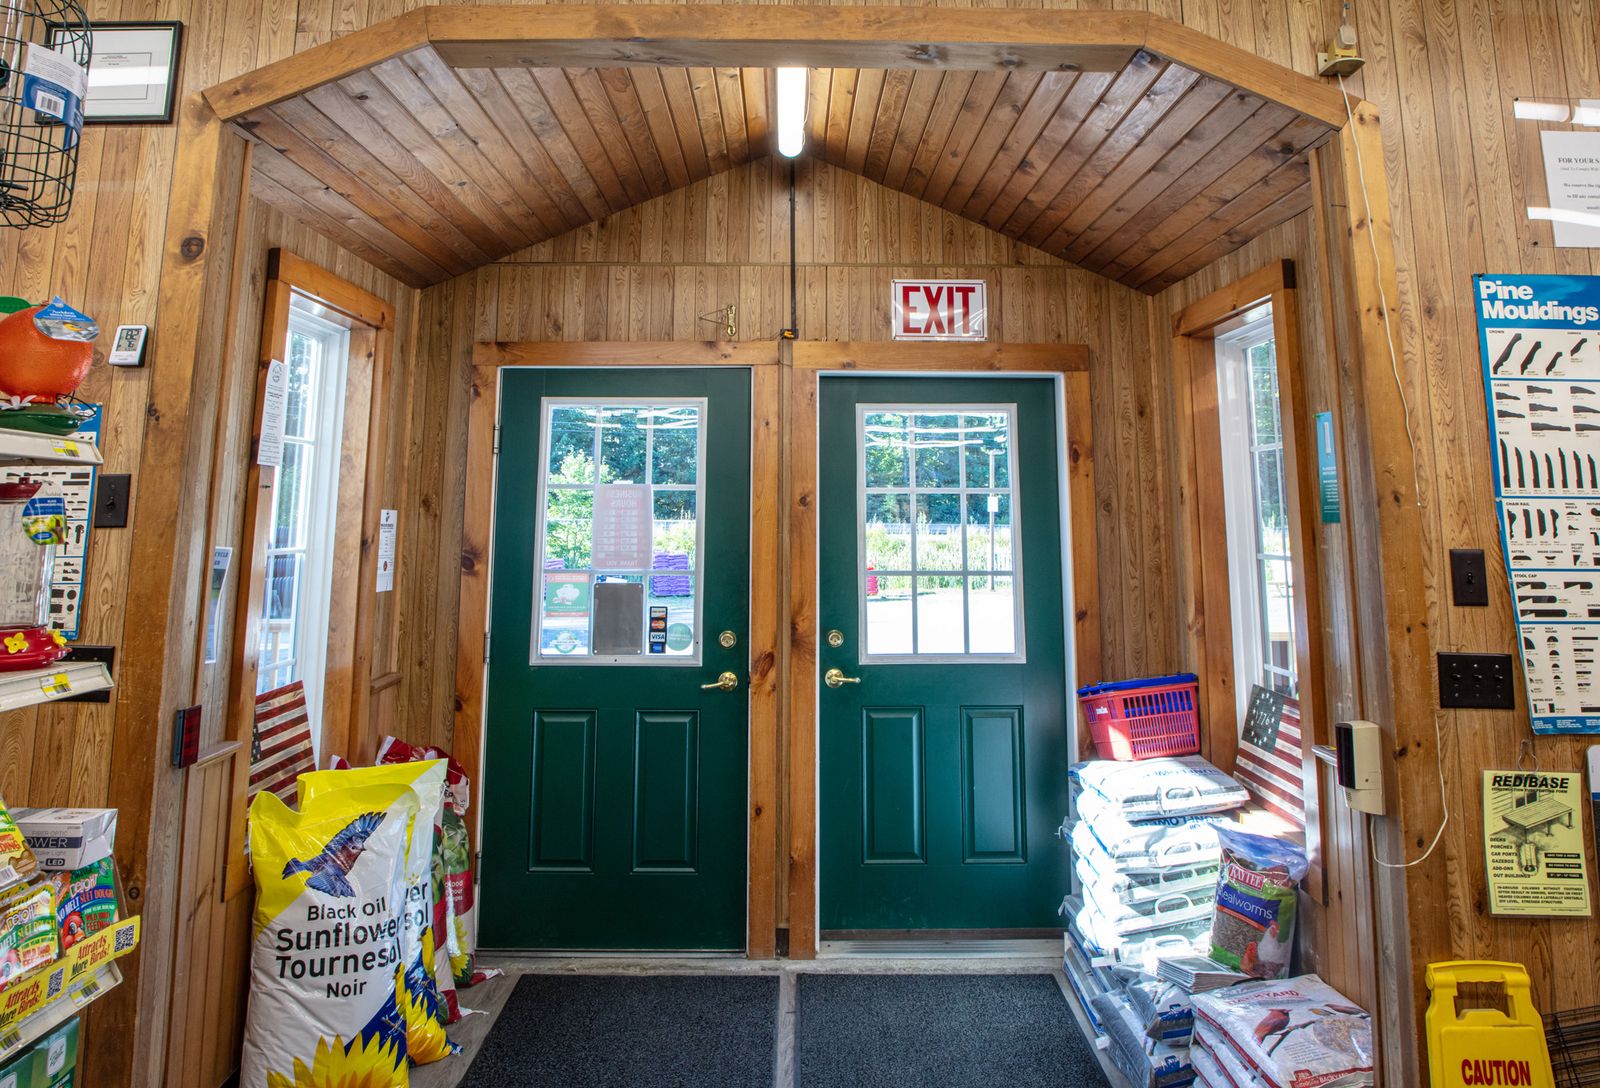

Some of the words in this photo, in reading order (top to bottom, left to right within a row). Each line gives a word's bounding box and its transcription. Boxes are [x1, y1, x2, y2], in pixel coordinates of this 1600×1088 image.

[1479, 280, 1533, 300] Pine
[902, 286, 976, 334] EXIT
[1481, 300, 1599, 325] Mouldings
[1491, 775, 1570, 789] REDIBASE
[47, 858, 65, 867] LED
[1229, 866, 1264, 888] KAYTEE
[65, 896, 80, 912] MELT
[307, 904, 357, 921] Black
[363, 896, 387, 916] Oil
[1220, 889, 1274, 920] ealworms
[77, 935, 108, 960] Attracts
[275, 937, 402, 979] Tournesol
[71, 959, 88, 976] More
[3, 979, 41, 1010] Attracts
[326, 979, 368, 999] Noir
[1461, 1058, 1532, 1087] CAUTION
